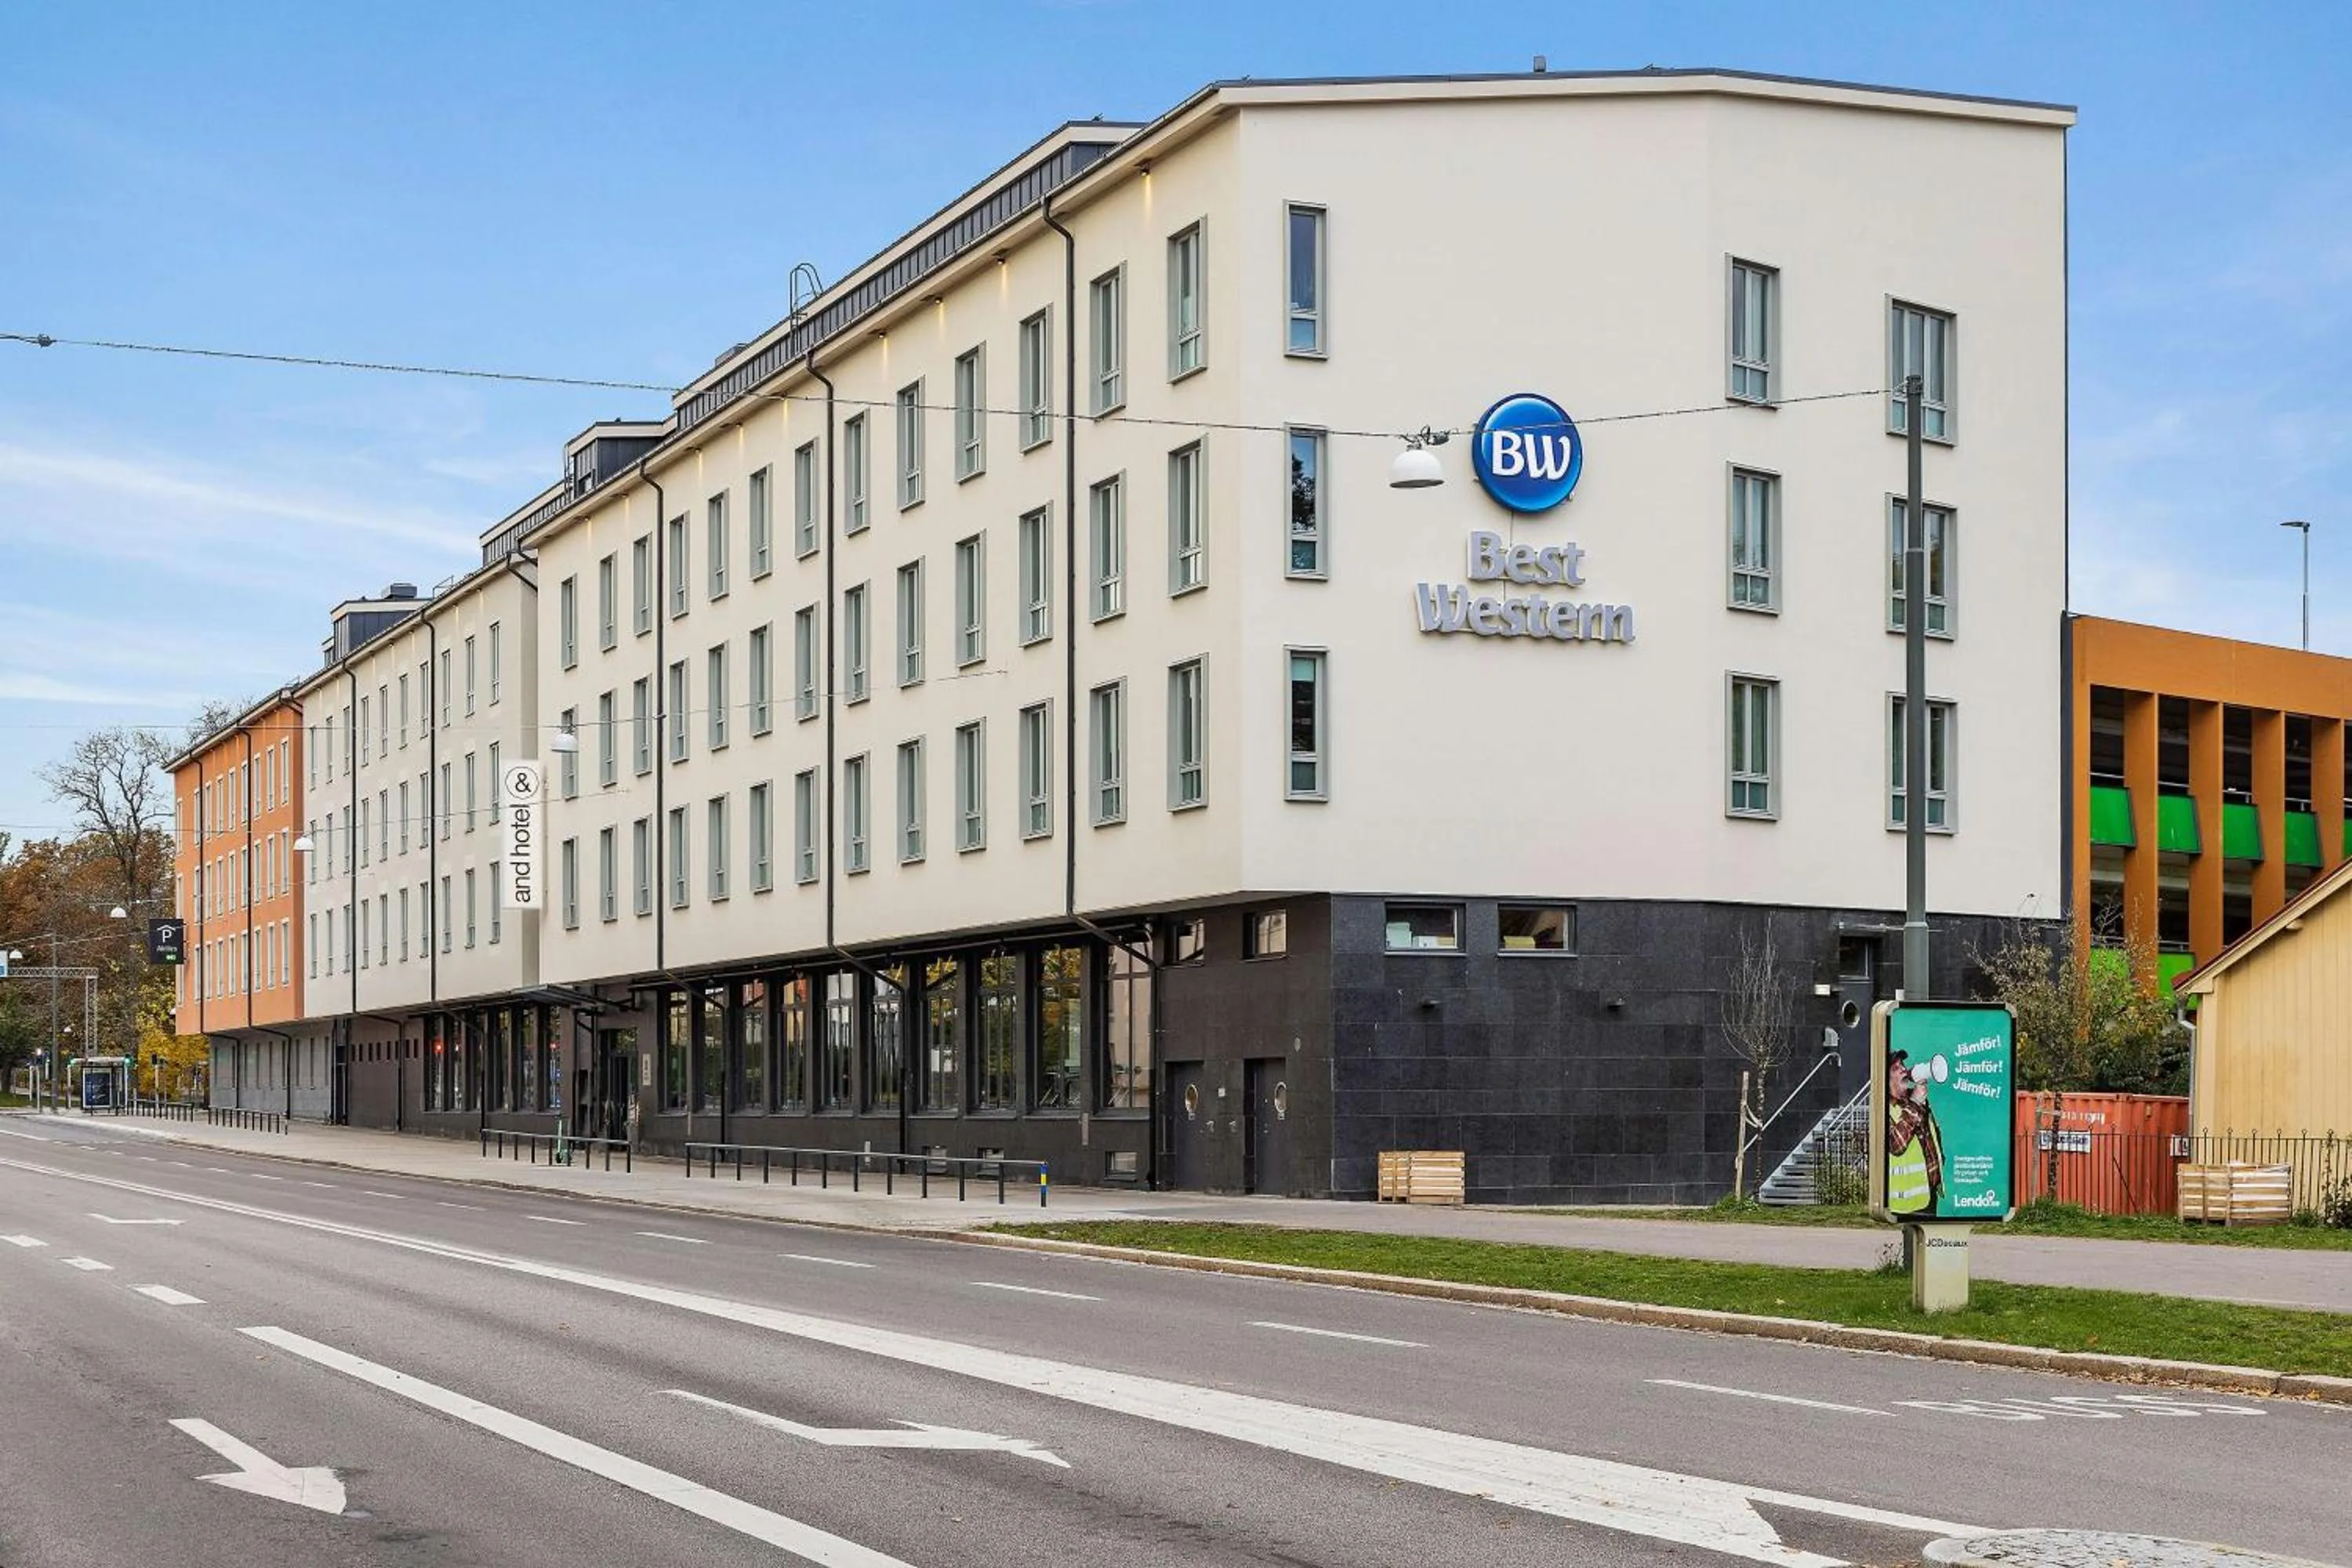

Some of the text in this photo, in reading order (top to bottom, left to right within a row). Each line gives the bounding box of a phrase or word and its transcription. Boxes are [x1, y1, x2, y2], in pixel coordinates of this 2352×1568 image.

[1492, 430, 1570, 481] BW
[1467, 531, 1585, 586] Best
[1416, 583, 1635, 643] Western
[510, 804, 531, 902] and hotel
[1955, 1035, 2001, 1057] Jämför!
[1955, 1060, 2003, 1073] Jämför!
[1953, 1077, 2002, 1098] Jämför!
[1891, 1395, 2268, 1421] BUSS
